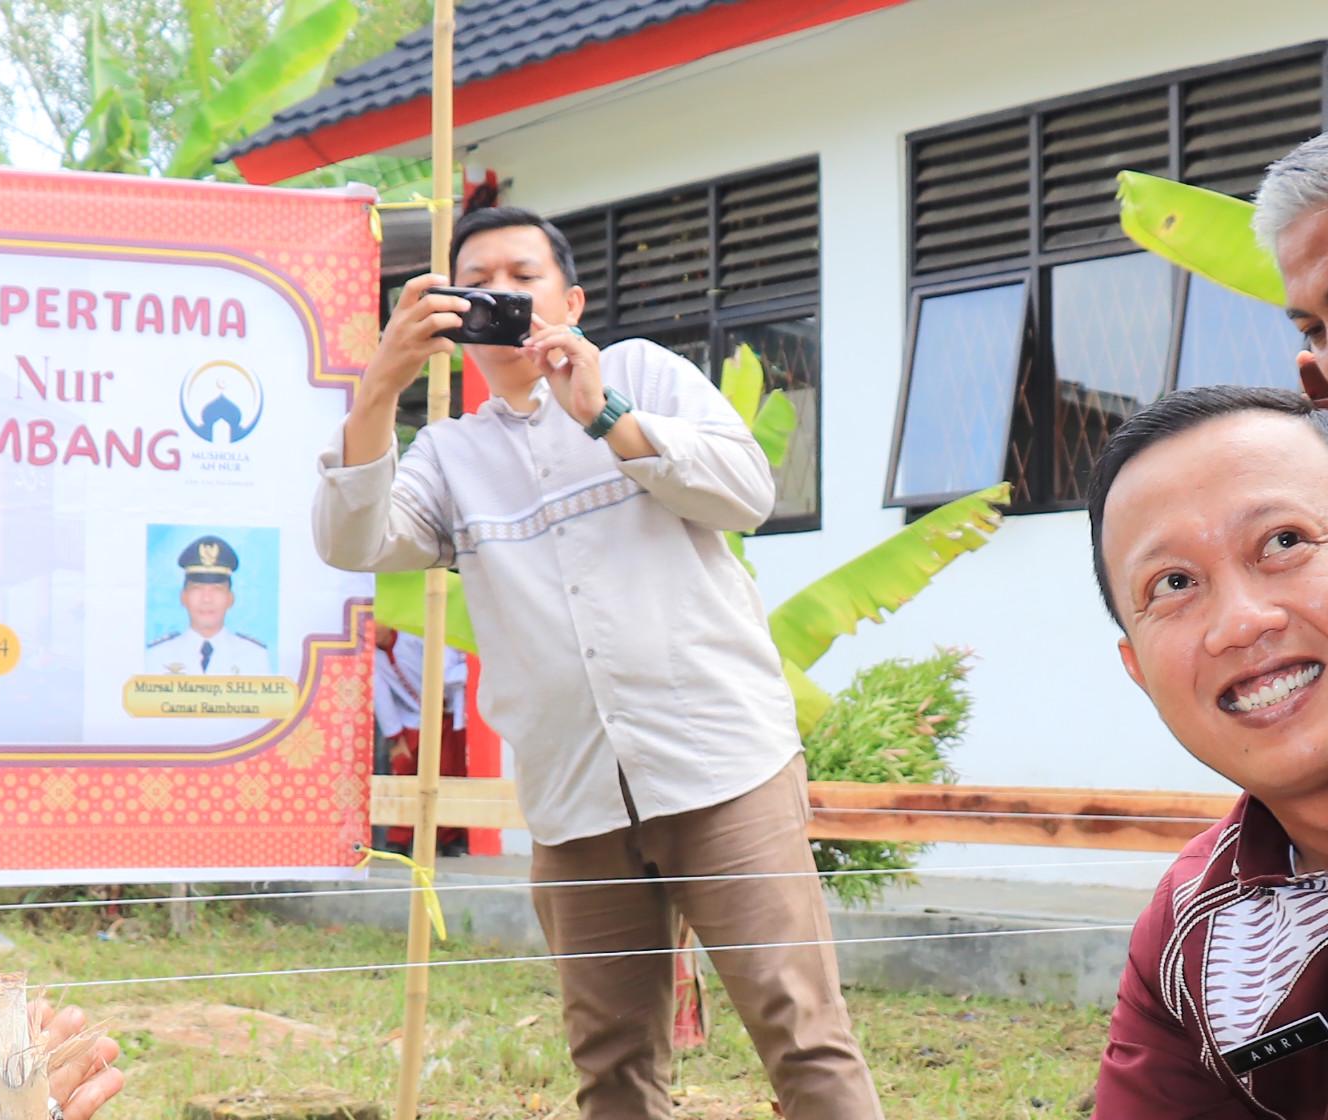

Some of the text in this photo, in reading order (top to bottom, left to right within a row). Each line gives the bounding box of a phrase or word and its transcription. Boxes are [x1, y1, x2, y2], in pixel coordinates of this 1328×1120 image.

[0, 285, 247, 338] PERTAMA
[15, 354, 115, 403] Nur
[1251, 1033, 1303, 1061] AMRI
